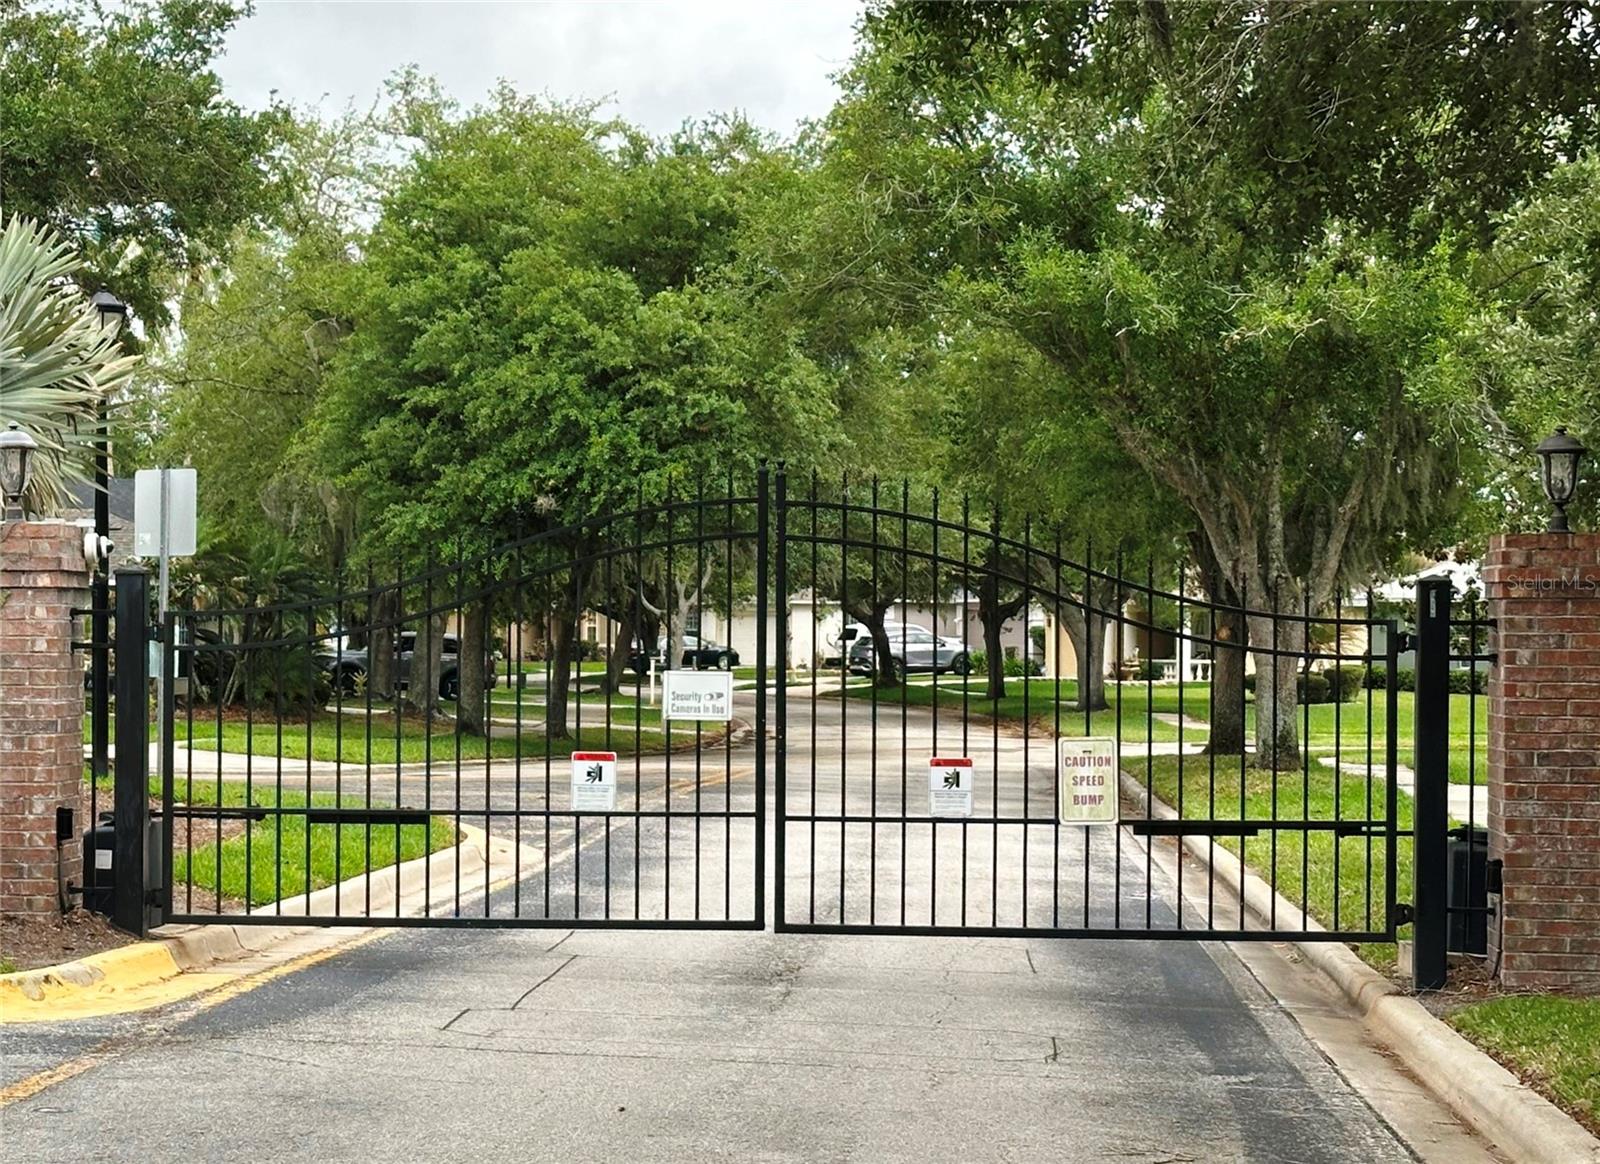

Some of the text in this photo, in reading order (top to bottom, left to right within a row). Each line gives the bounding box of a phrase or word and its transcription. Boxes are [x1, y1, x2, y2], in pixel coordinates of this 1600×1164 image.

[671, 691, 702, 703] Security
[1064, 756, 1111, 767] CAUTION
[1072, 775, 1105, 786] SPEED
[1073, 794, 1105, 806] BUMP
